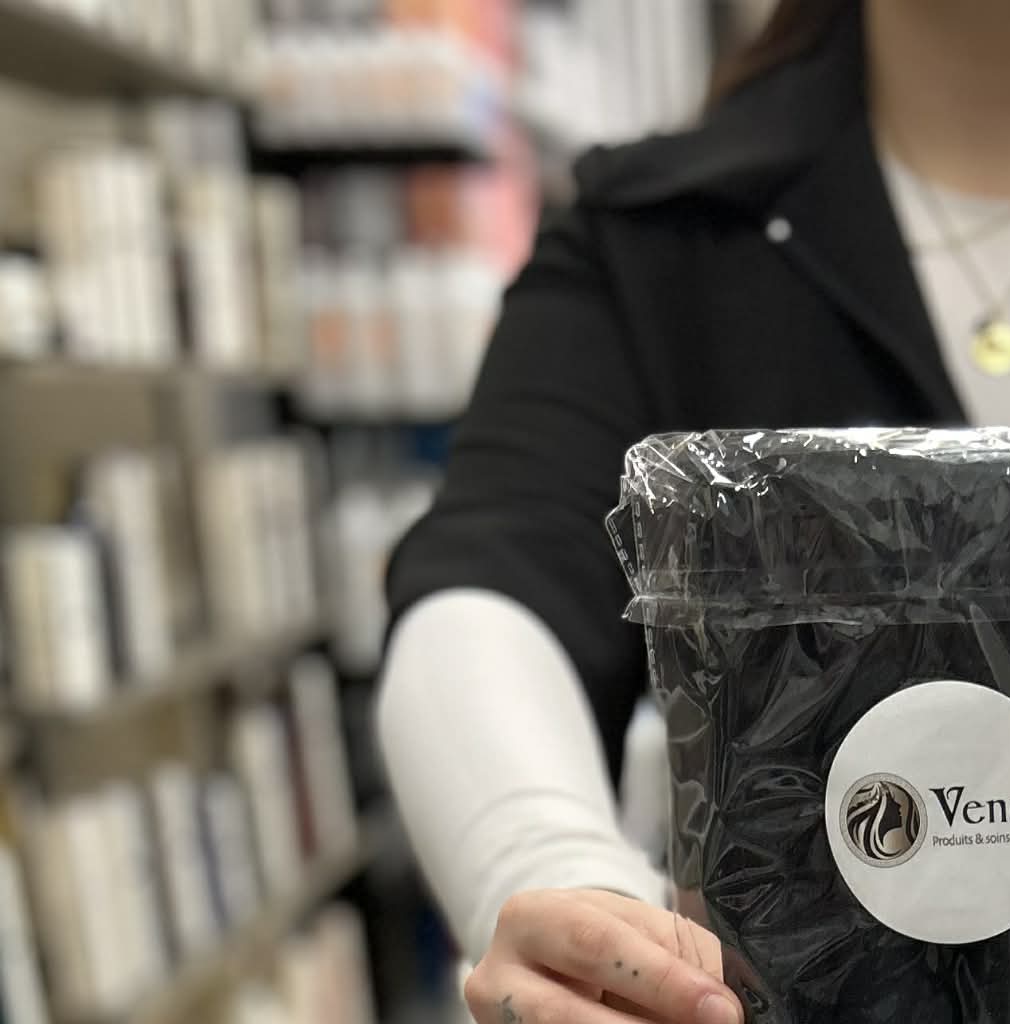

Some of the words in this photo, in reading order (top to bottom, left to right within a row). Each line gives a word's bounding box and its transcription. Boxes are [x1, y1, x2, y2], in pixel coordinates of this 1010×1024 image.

[932, 832, 974, 847] Produits
[975, 832, 985, 845] &
[986, 832, 1010, 845] soins
